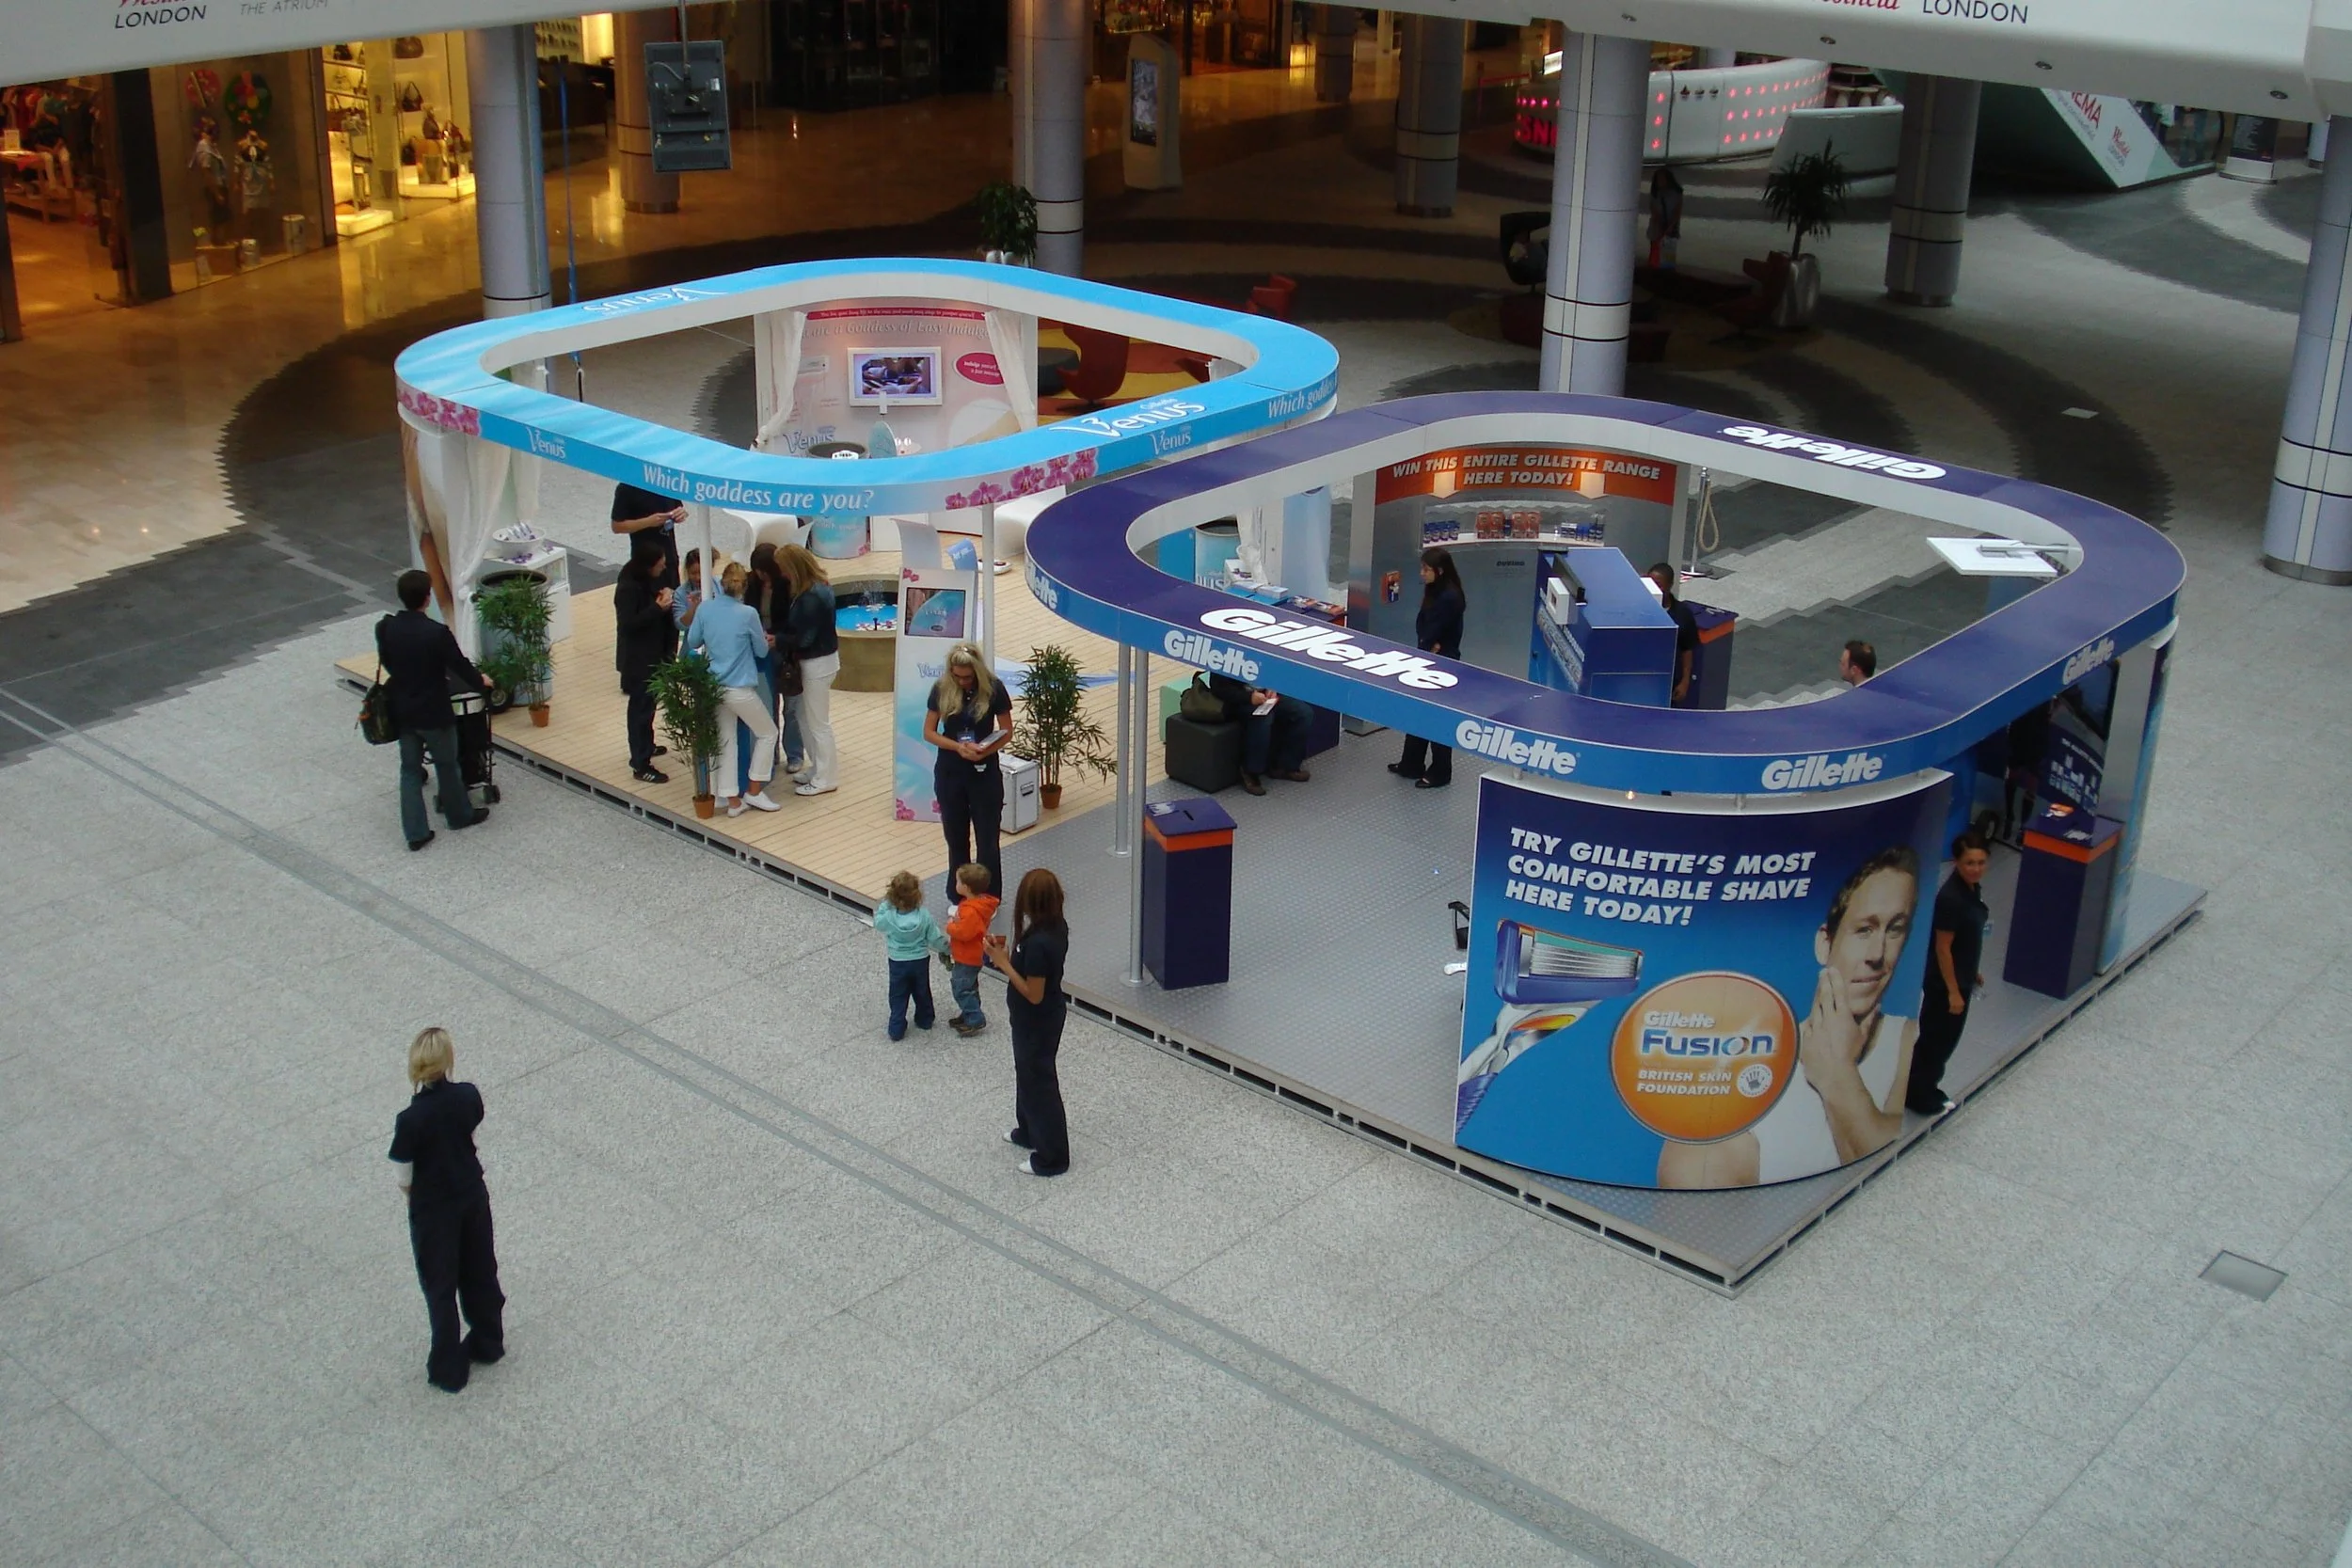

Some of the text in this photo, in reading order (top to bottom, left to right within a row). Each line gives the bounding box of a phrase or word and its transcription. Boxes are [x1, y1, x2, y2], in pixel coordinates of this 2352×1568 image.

[115, 5, 206, 29] LONDON
[240, 3, 267, 15] THE
[1922, 0, 2028, 24] LONDON
[847, 320, 897, 334] Goddess
[898, 320, 913, 334] of
[1268, 391, 1305, 419] Which
[1049, 401, 1206, 438] Venus
[525, 426, 566, 459] Venus
[783, 430, 835, 453] Venus
[1150, 430, 1191, 455] Venus
[1724, 426, 1947, 479] Gillette
[1393, 454, 1661, 480] WIN THIS ENTIRE GILLETTE RANGE
[1463, 471, 1574, 485] HERE TODAY!
[643, 464, 875, 514] Which goddess are you?
[1164, 629, 1260, 681] Gillette
[1200, 609, 1459, 689] Gillette
[1455, 721, 1577, 775] Gillette
[1761, 752, 1883, 791] Gillette
[1510, 827, 1816, 875] TRY GILLETTE'S MOST
[1508, 855, 1811, 901] COMFORTABLE SHAVE
[1505, 879, 1693, 926] HERE TODAY!
[1644, 1010, 1716, 1029] Gillette
[1642, 1028, 1773, 1056] Fusion
[1636, 1083, 1732, 1096] FOUNDATION
[1638, 1069, 1733, 1083] BRITISH SKIN
